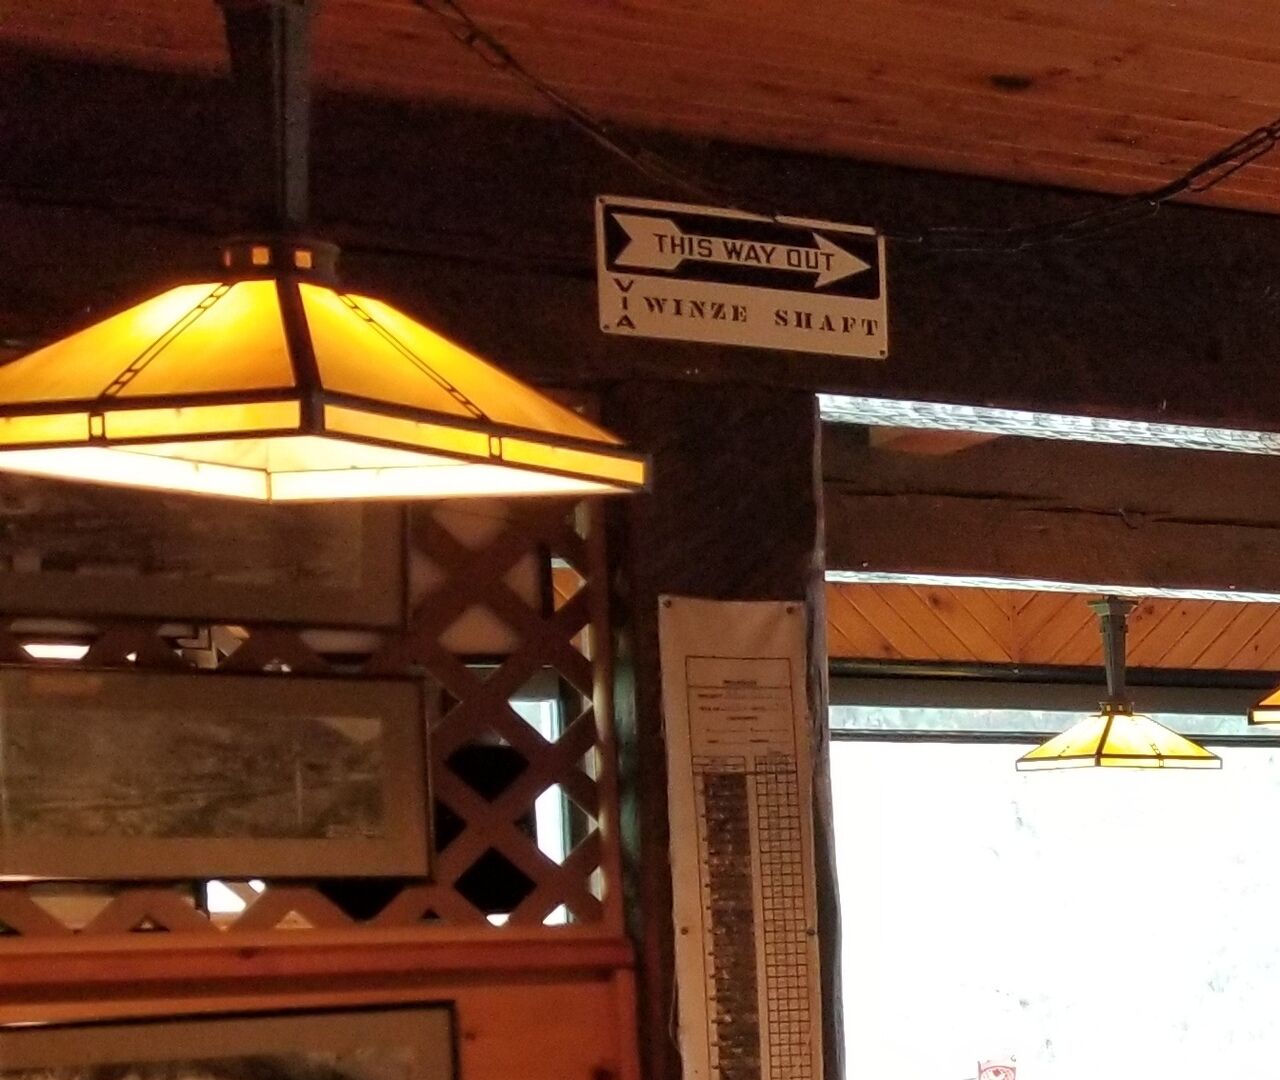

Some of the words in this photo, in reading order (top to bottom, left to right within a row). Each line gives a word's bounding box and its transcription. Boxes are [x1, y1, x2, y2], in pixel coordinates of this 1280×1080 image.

[652, 232, 713, 259] THIS
[722, 240, 777, 265] WAY
[786, 249, 835, 272] OUT
[613, 278, 637, 330] VIA
[643, 296, 748, 323] WINZE
[774, 309, 879, 337] SHAFT
